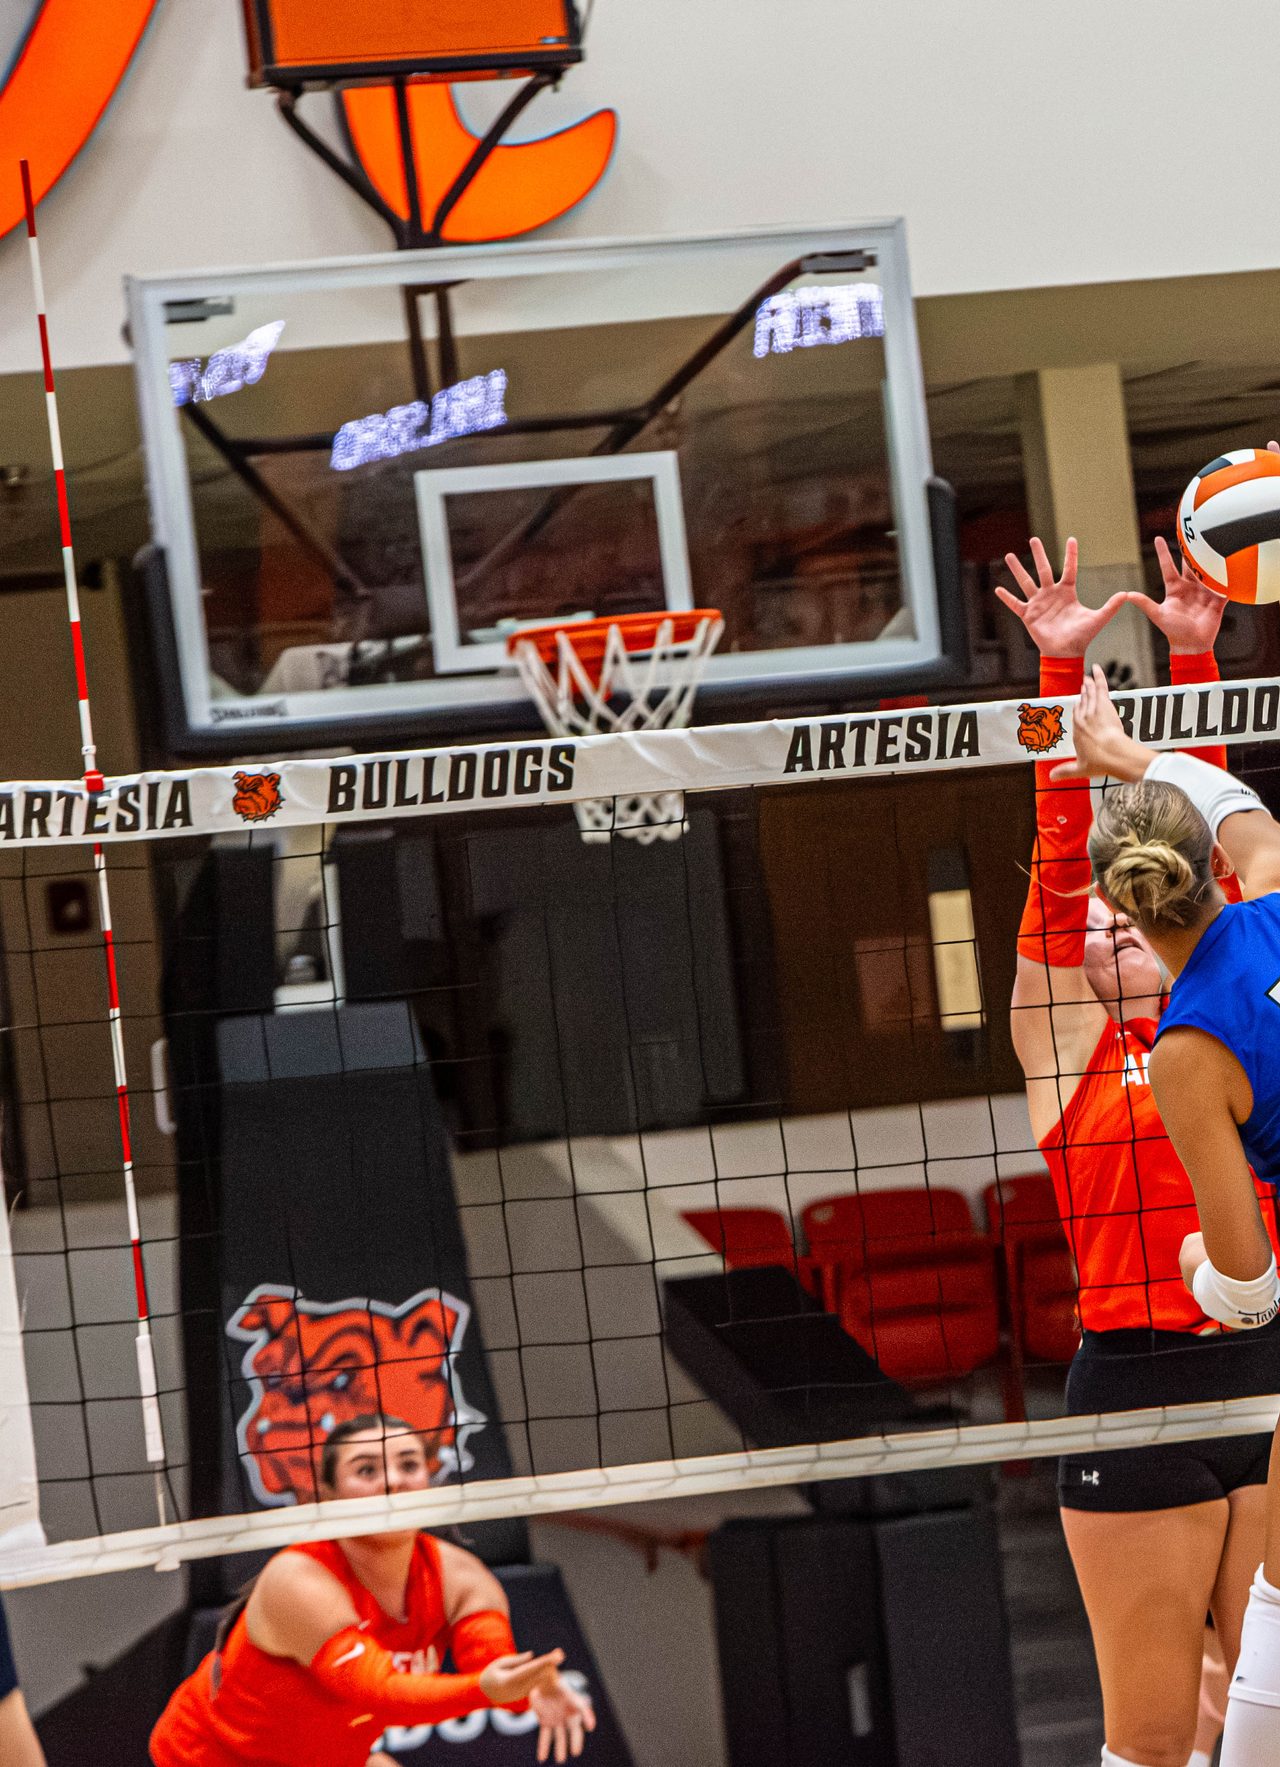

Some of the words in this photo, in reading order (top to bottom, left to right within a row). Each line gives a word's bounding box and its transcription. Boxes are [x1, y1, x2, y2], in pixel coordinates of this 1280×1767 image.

[0, 780, 192, 840] ARTESIA
[326, 744, 576, 813] BULLDOGS
[783, 710, 981, 773] ARTESIA
